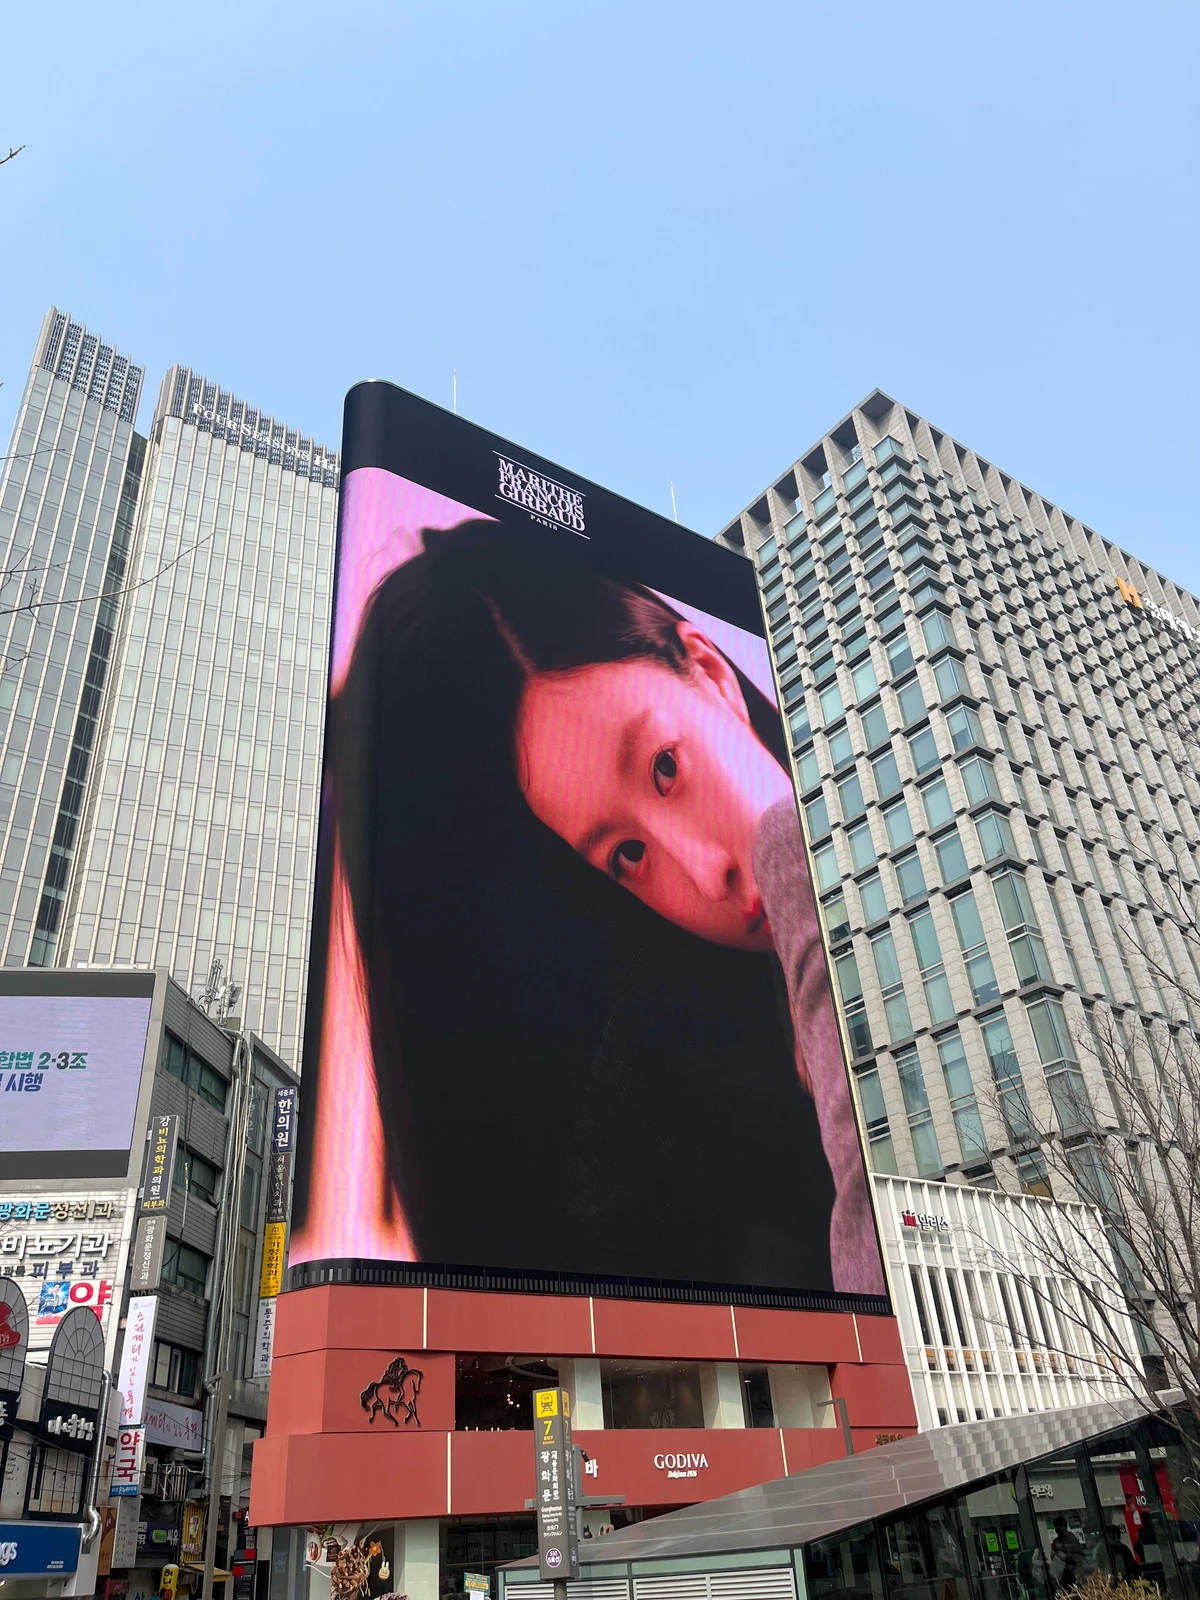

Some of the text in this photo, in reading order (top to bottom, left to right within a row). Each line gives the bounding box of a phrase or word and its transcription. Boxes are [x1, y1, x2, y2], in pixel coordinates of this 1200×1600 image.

[191, 402, 237, 431] FOUR
[241, 423, 310, 461] SEASONS
[499, 482, 585, 531] GIRBAUD
[530, 514, 558, 531] PARIS
[0, 1051, 34, 1070] 합법
[4, 1072, 44, 1092] 시행
[275, 1098, 293, 1148] 한의원
[143, 1200, 165, 1209] 피부과
[917, 1213, 950, 1232] 할리스
[2, 1232, 114, 1261] 비뇨기과
[266, 1241, 280, 1276] 가정의학과
[32, 1261, 99, 1280] 피부과
[260, 1308, 273, 1363] 통증의학과
[543, 1420, 553, 1436] 7
[116, 1431, 140, 1483] 약국
[654, 1453, 709, 1469] GODIVA
[540, 1450, 552, 1502] 광화문
[585, 1459, 598, 1478] 바
[1029, 1483, 1053, 1497] 리브영
[0, 1541, 18, 1566] gs
